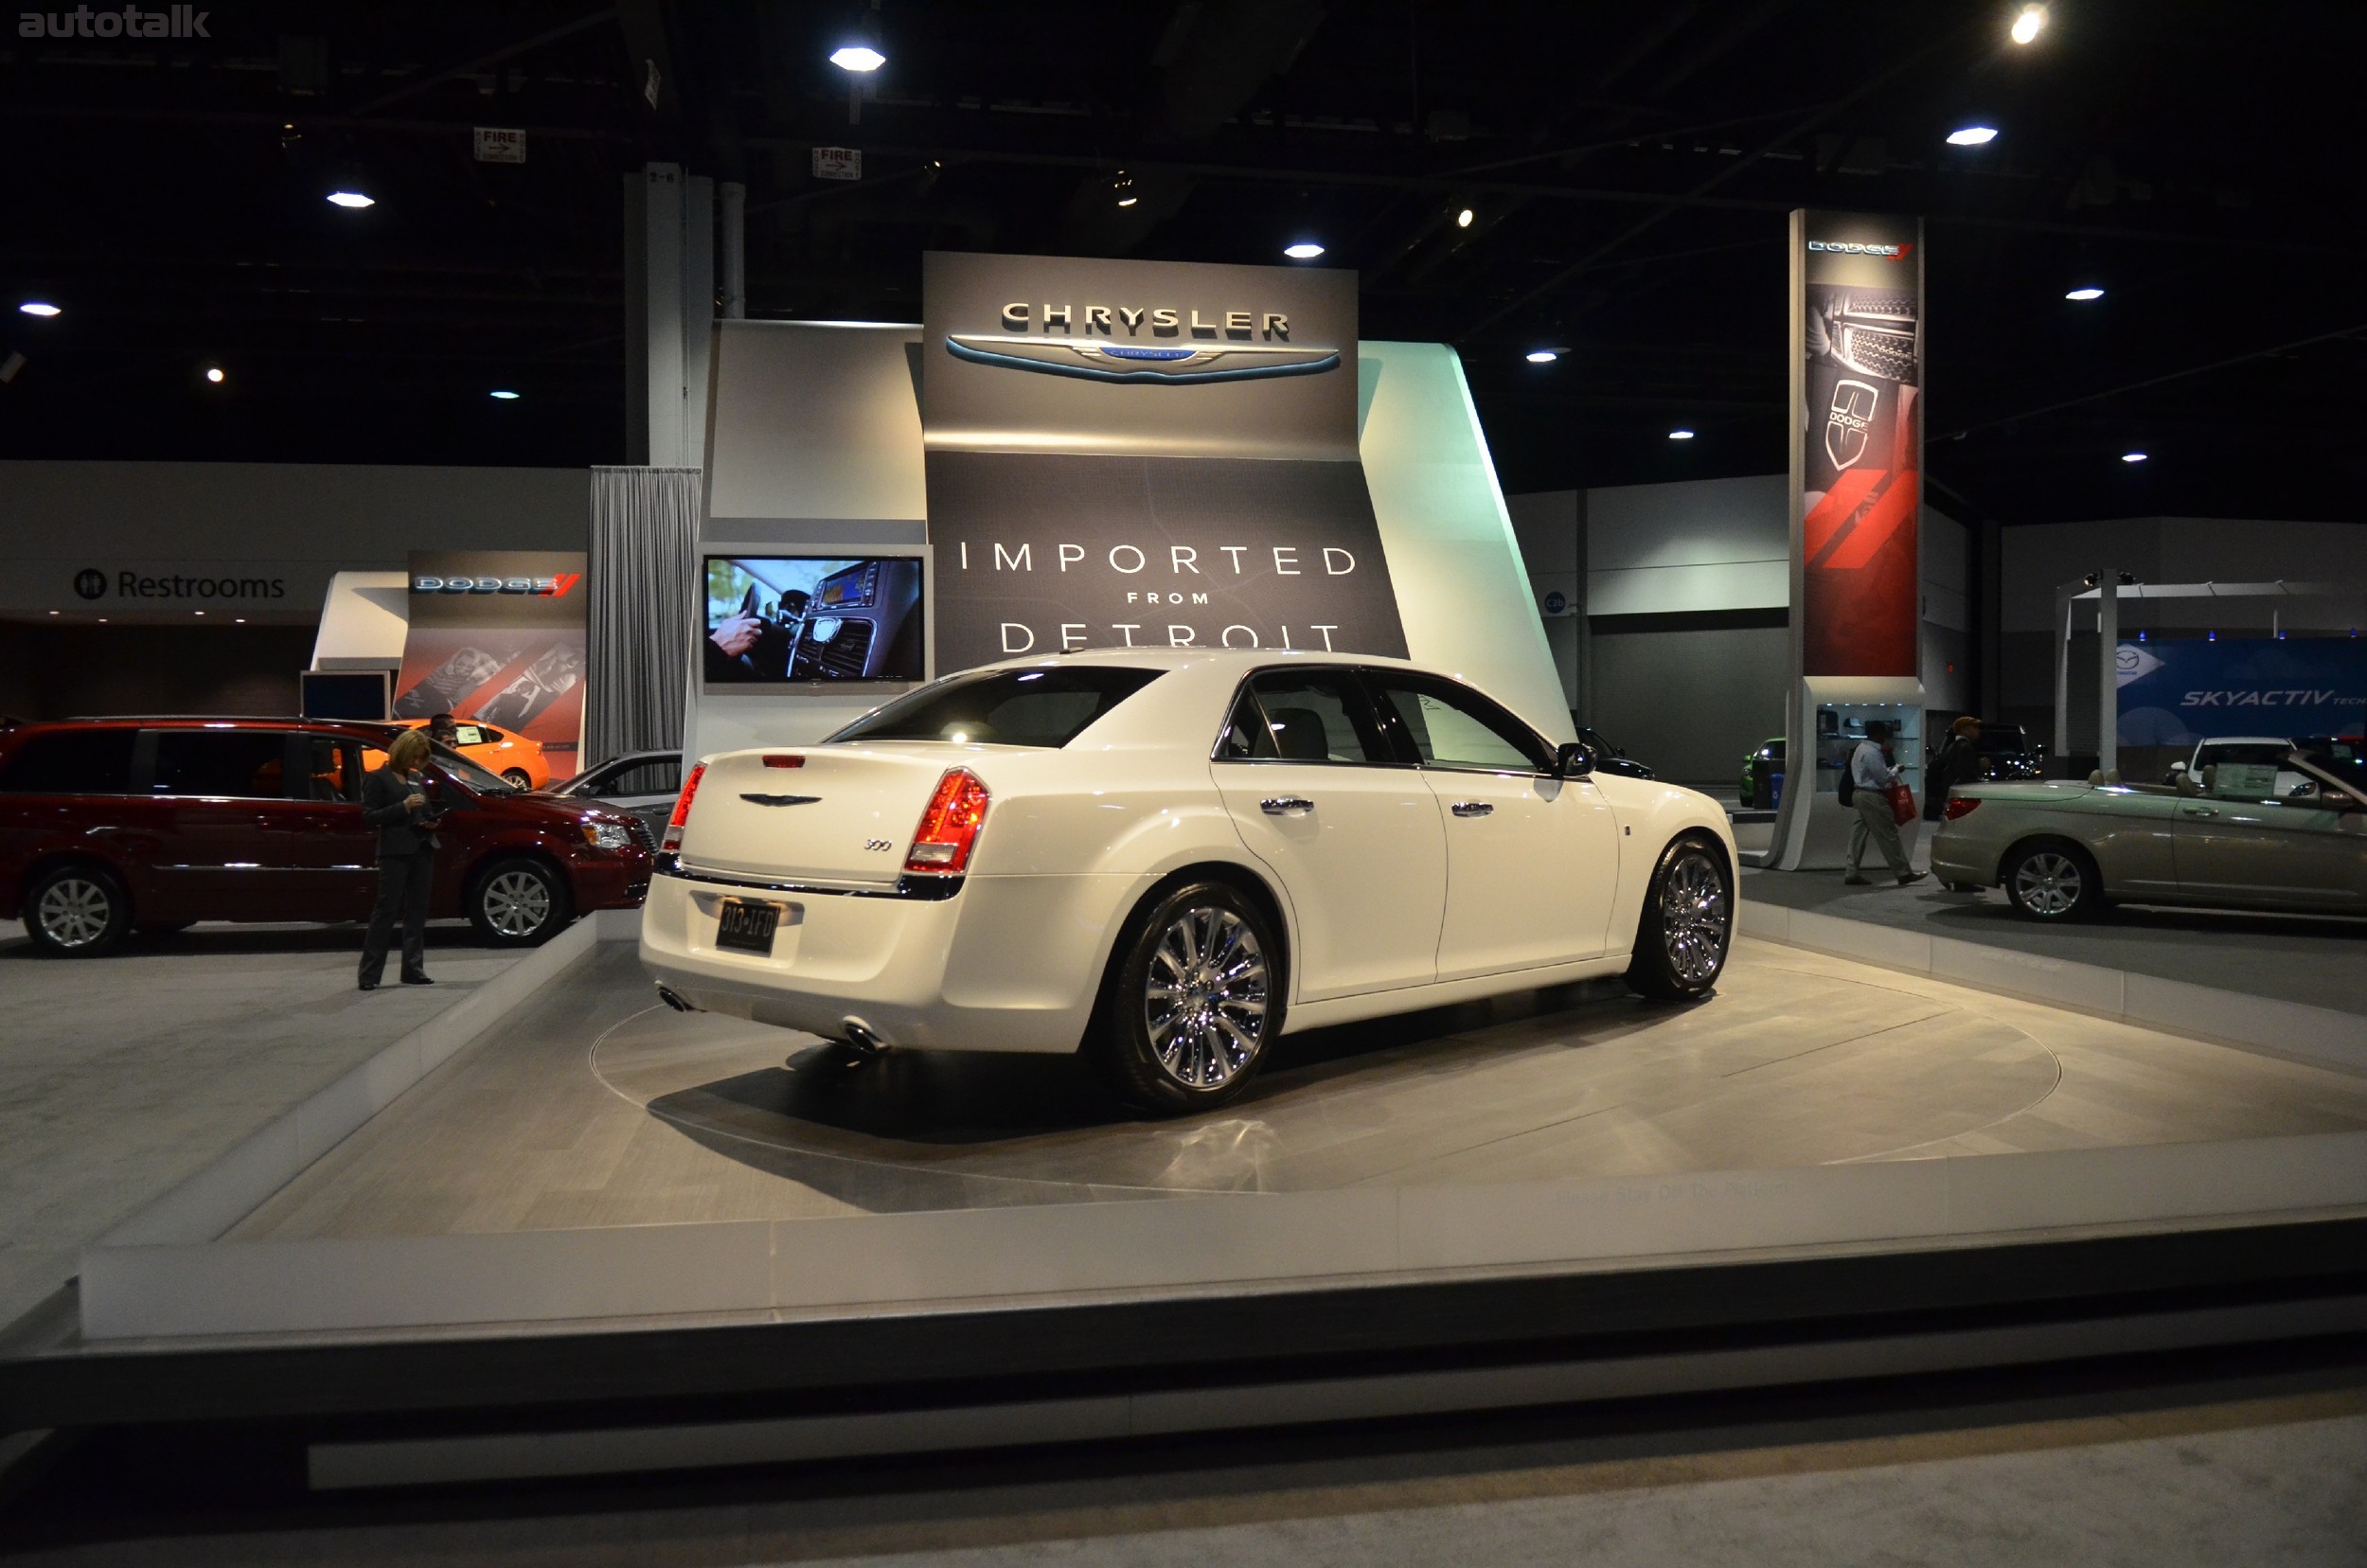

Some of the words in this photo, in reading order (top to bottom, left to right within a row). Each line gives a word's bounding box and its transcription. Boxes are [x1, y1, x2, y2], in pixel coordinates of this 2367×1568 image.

[484, 131, 517, 143] FIRE
[821, 150, 852, 161] FIRE
[1808, 241, 1900, 256] DODGE
[1003, 303, 1290, 334] CHRYSLER
[1829, 412, 1870, 432] DODGE
[961, 542, 1356, 575] IMPORTED
[118, 571, 285, 598] Restrooms
[414, 576, 559, 593] DODGE
[1128, 592, 1208, 604] FROM
[1001, 623, 1339, 653] DETROIT
[2180, 689, 2335, 705] SKYACTIV
[2333, 697, 2367, 706] TECH
[1617, 1186, 1651, 1203] Stay
